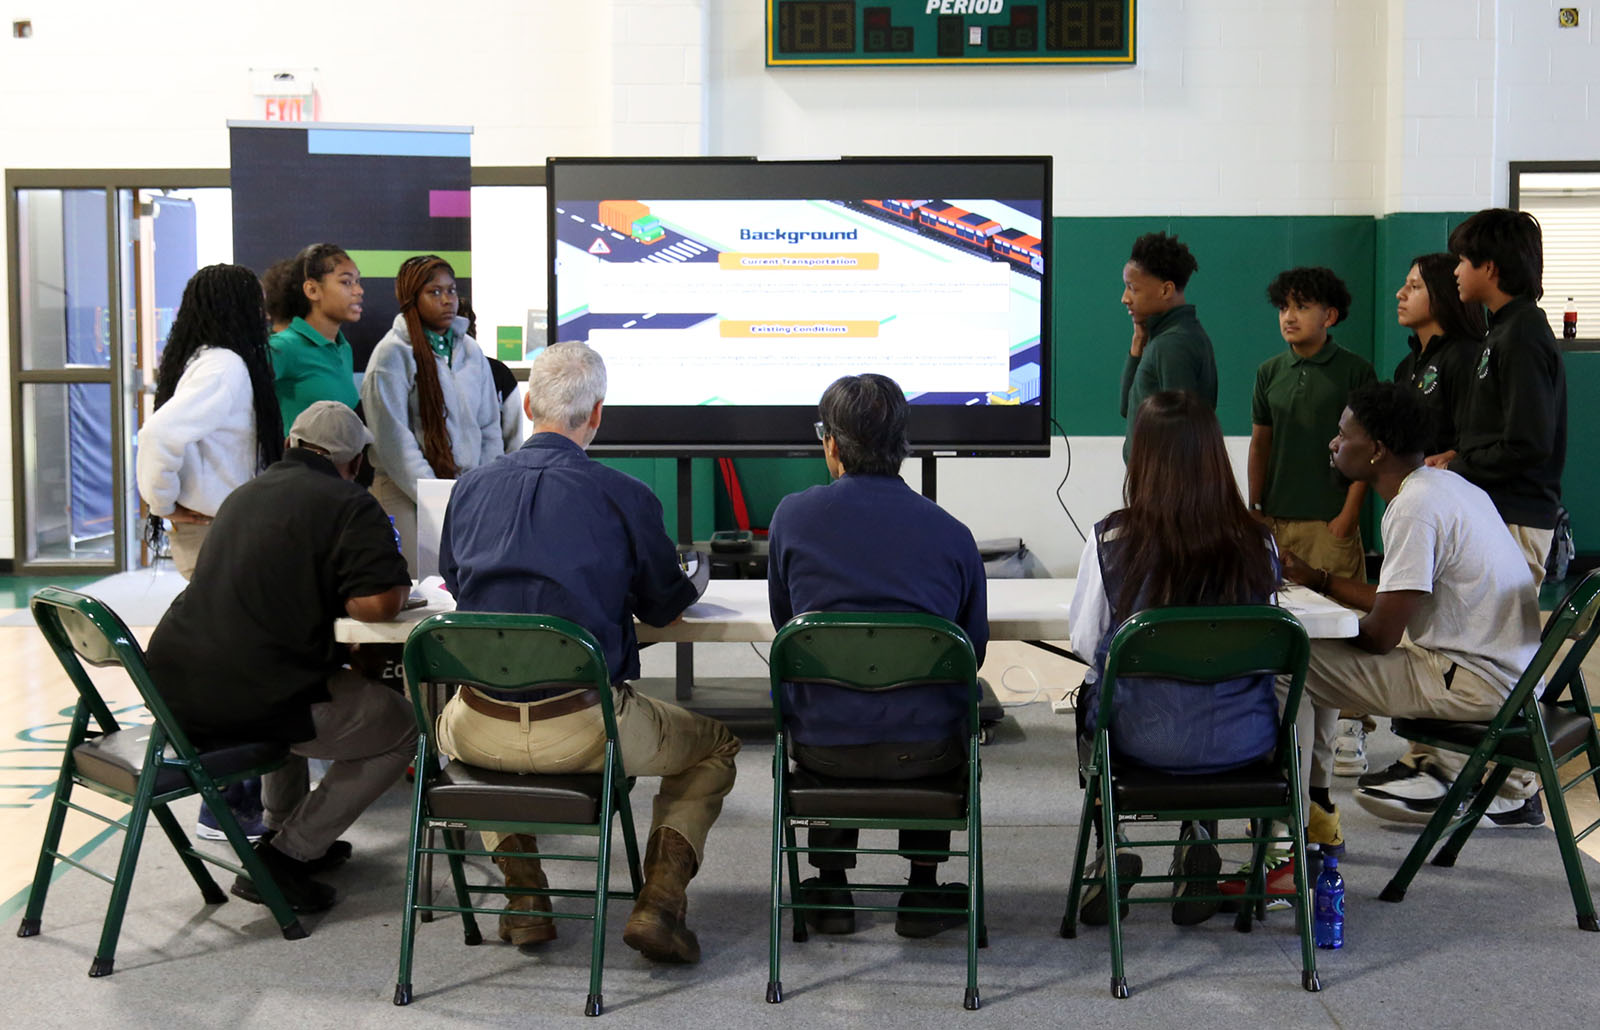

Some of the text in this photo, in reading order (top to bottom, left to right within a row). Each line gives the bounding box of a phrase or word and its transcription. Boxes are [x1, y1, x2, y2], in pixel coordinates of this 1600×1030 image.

[925, 0, 1004, 15] PERIOD
[265, 97, 305, 121] EXIT
[740, 228, 858, 244] Background
[782, 258, 857, 267] Transportation
